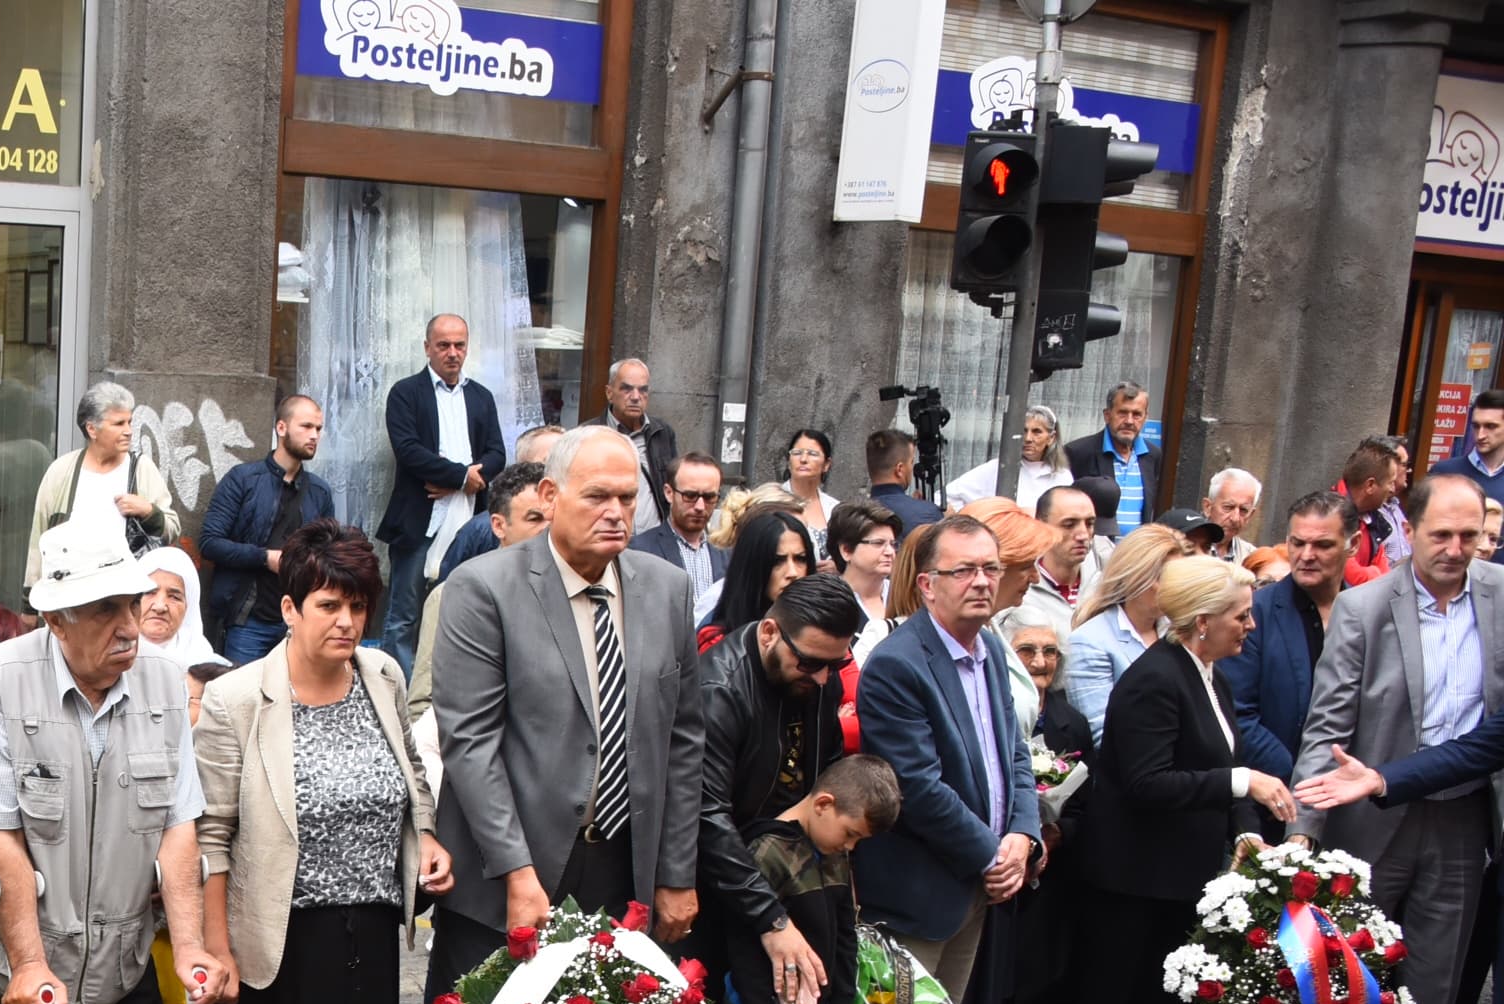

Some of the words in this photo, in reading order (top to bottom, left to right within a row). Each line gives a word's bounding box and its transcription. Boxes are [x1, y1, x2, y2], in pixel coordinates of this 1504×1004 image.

[351, 35, 543, 83] Posteljine.ba
[860, 86, 905, 96] Posteljine.ba
[27, 148, 58, 175] 128
[1438, 390, 1462, 400] KCIJA
